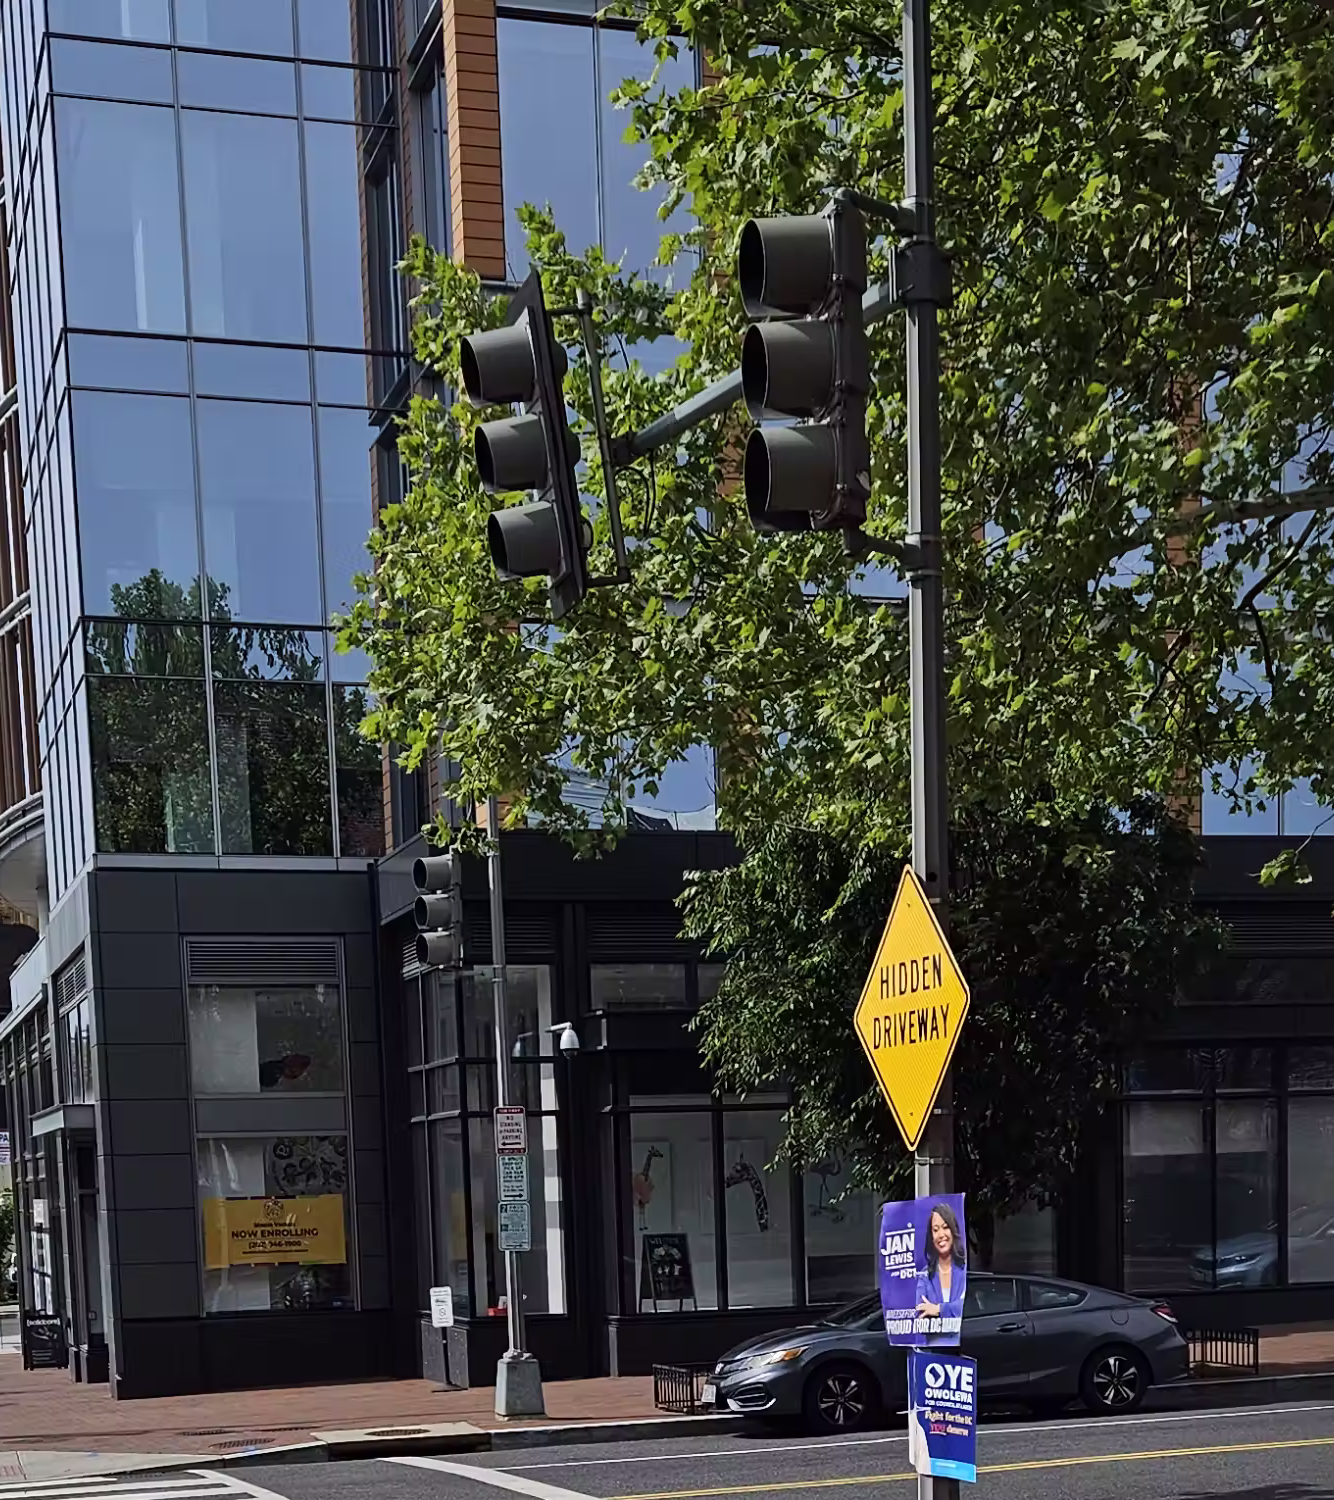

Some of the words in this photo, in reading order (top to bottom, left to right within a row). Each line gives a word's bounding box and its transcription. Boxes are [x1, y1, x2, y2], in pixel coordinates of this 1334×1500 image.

[881, 953, 942, 1000] HIDDEN
[874, 1003, 949, 1050] DRIVEWAY
[231, 1230, 258, 1239] NOW
[261, 1228, 319, 1238] ENROLLING
[885, 1252, 913, 1266] LEWIS
[925, 1363, 973, 1392] OYE
[925, 1388, 972, 1404] OWOLEWA
[925, 1410, 943, 1423] Fight
